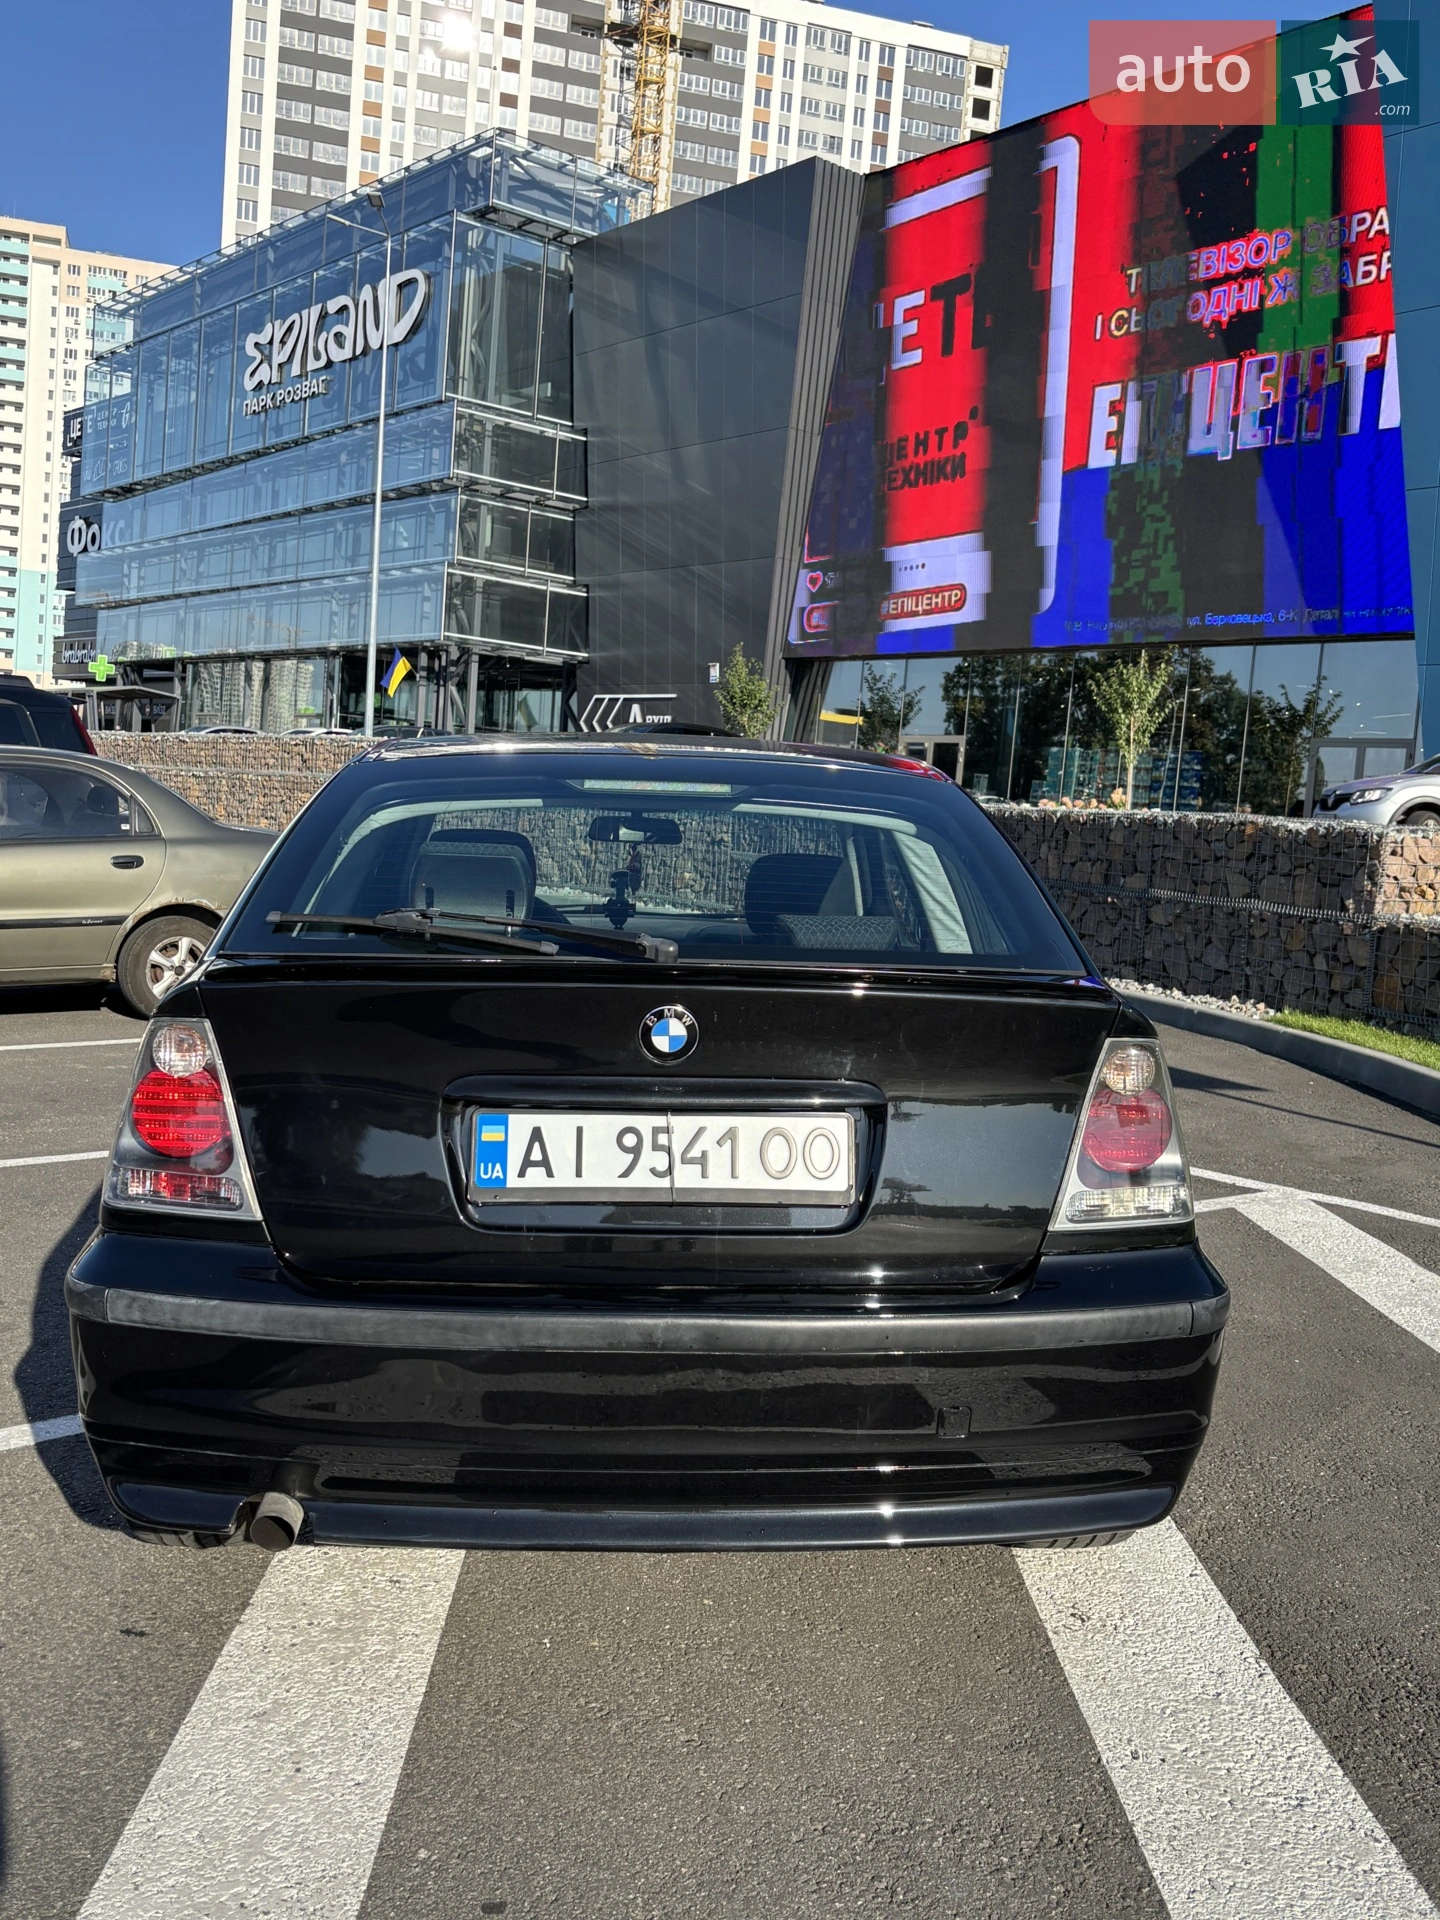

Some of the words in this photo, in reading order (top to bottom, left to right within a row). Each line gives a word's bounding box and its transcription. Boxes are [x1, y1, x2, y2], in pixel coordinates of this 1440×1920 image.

[243, 391, 274, 417] ПАРК
[277, 375, 329, 407] РОЗВАГ
[880, 590, 961, 616] #ЕПІЦЕНТР
[645, 1008, 693, 1027] BMW
[517, 1125, 584, 1179] AI
[615, 1125, 740, 1179] 9541
[480, 1162, 504, 1180] UA
